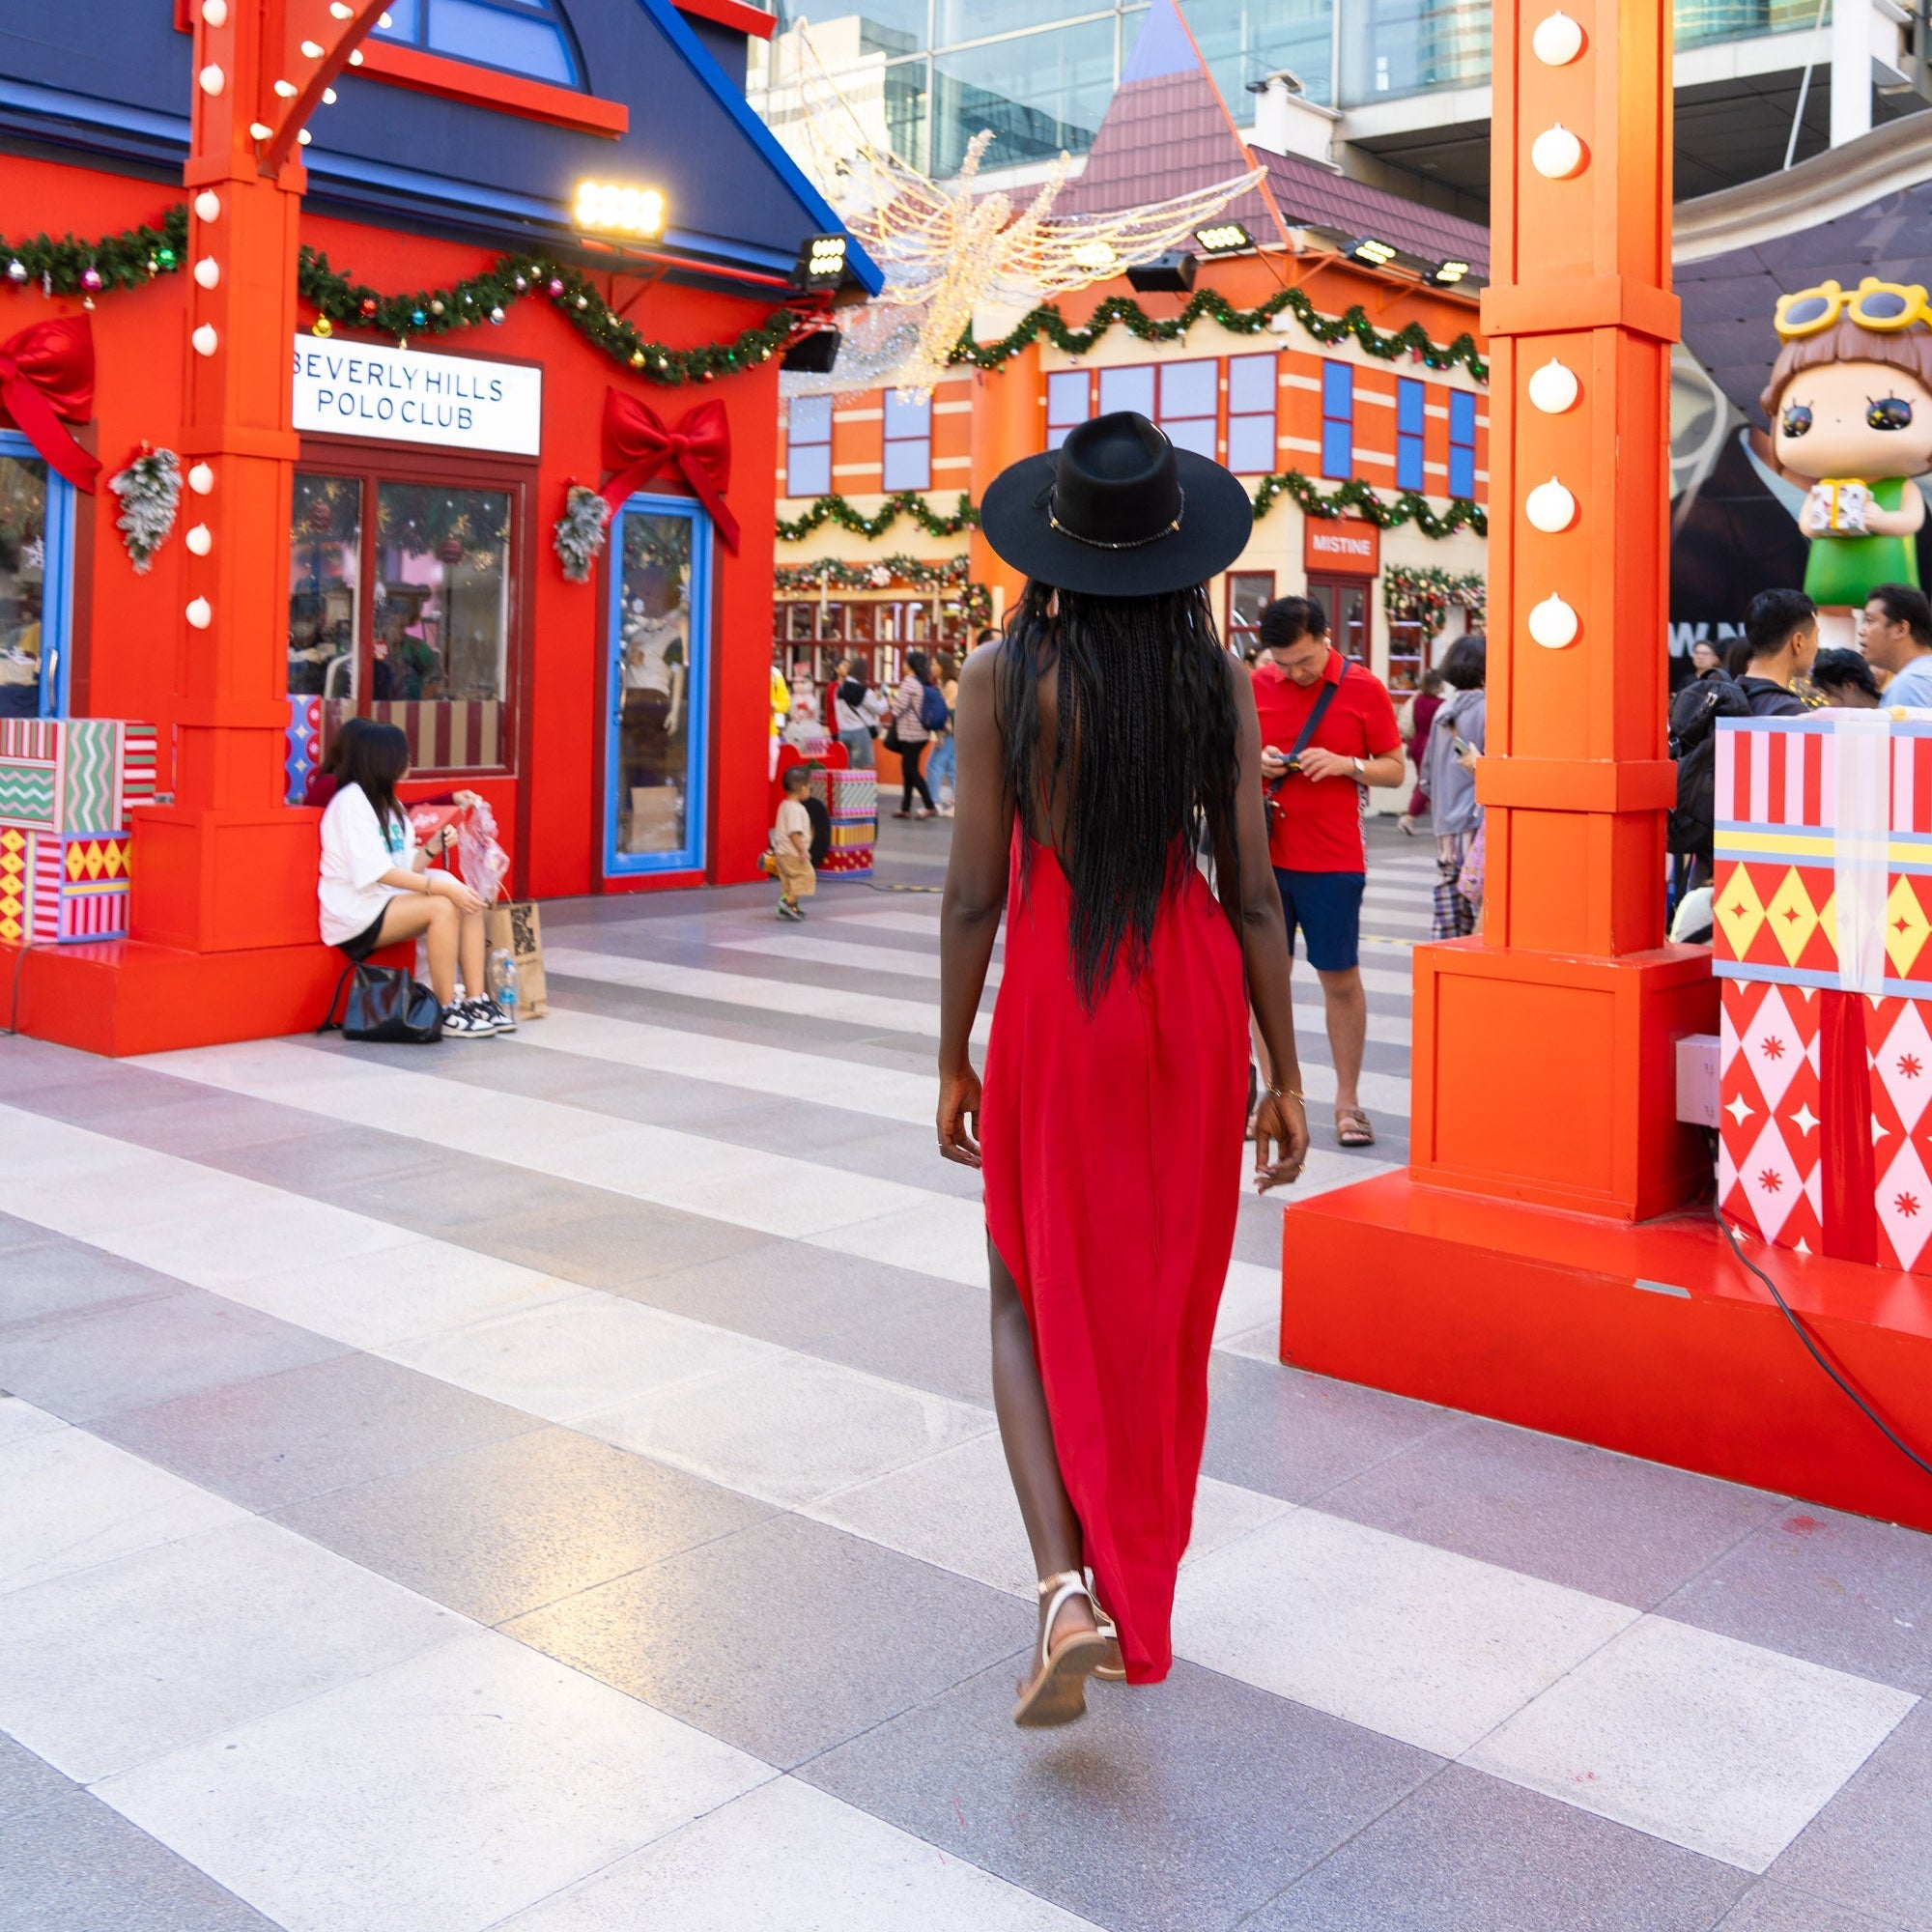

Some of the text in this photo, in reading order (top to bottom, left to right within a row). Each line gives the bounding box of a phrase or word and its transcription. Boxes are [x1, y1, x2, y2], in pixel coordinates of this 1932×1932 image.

[294, 352, 503, 402] BEVERLY HILLS
[318, 389, 472, 430] POLO CLUB
[1313, 534, 1372, 556] MISTINE
